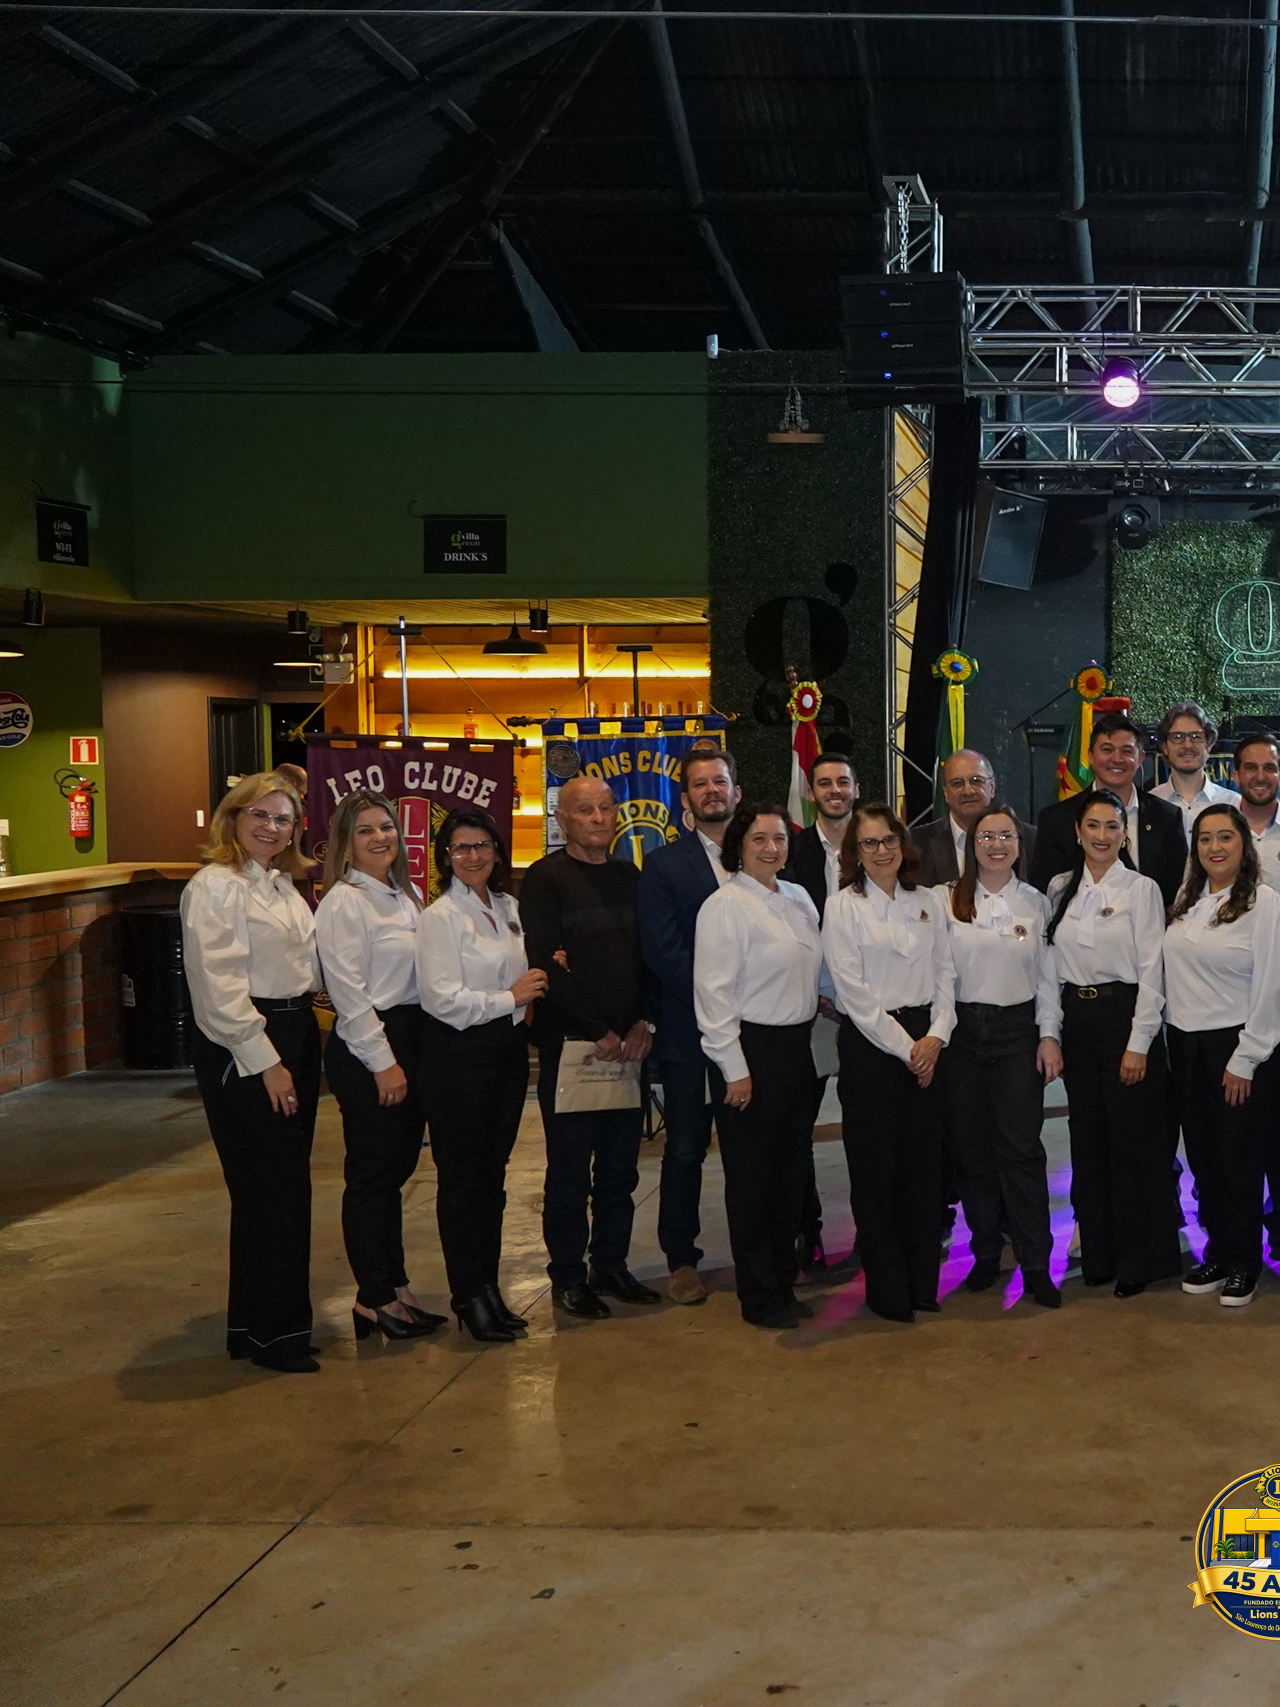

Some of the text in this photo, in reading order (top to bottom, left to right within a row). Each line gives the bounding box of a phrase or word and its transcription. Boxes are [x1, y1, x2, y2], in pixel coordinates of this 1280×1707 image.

[461, 532, 480, 540] villa
[326, 761, 498, 808] LEO CLUBE
